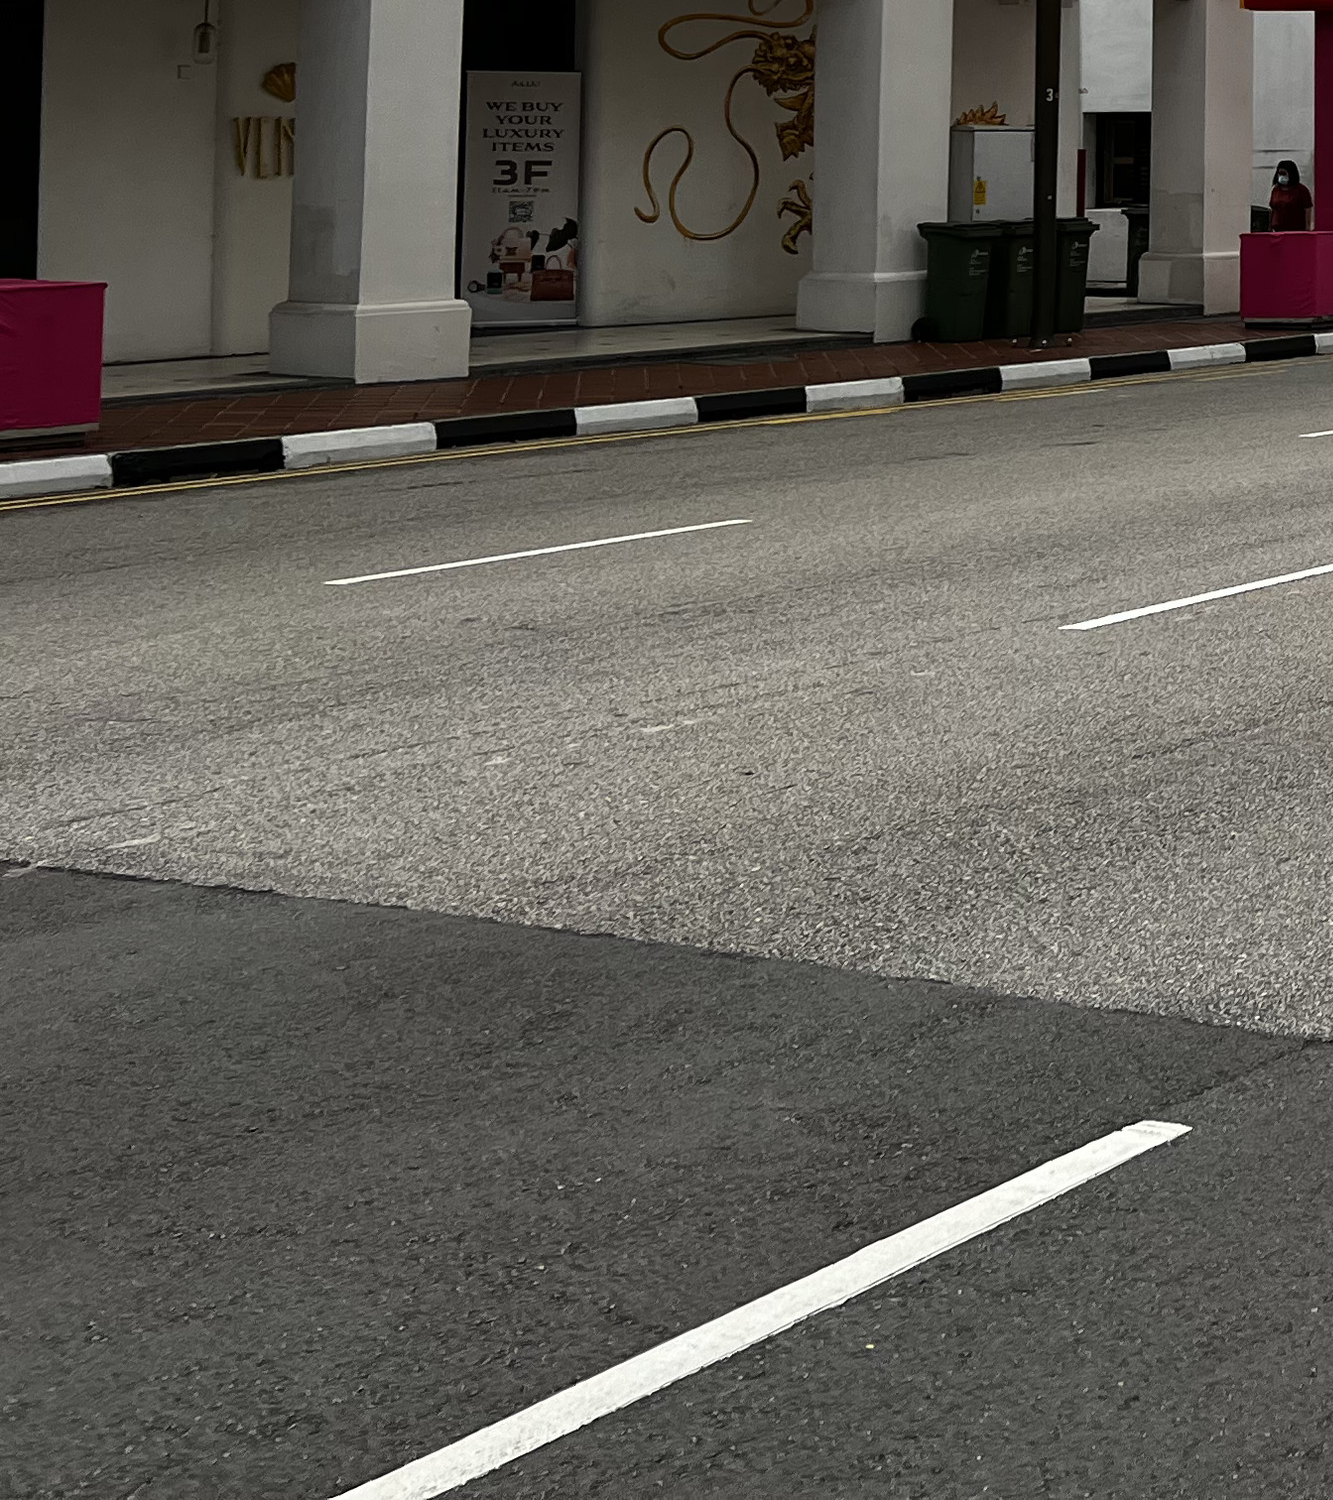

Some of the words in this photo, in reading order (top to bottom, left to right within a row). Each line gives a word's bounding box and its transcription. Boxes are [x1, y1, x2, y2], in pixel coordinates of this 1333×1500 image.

[1046, 88, 1054, 102] 3
[486, 102, 517, 112] WE
[522, 102, 565, 112] BUY
[496, 115, 552, 125] YOUR
[483, 128, 565, 139] LUXURY
[232, 116, 296, 179] VEN
[491, 142, 554, 152] ITEMS
[493, 160, 552, 186] 3F
